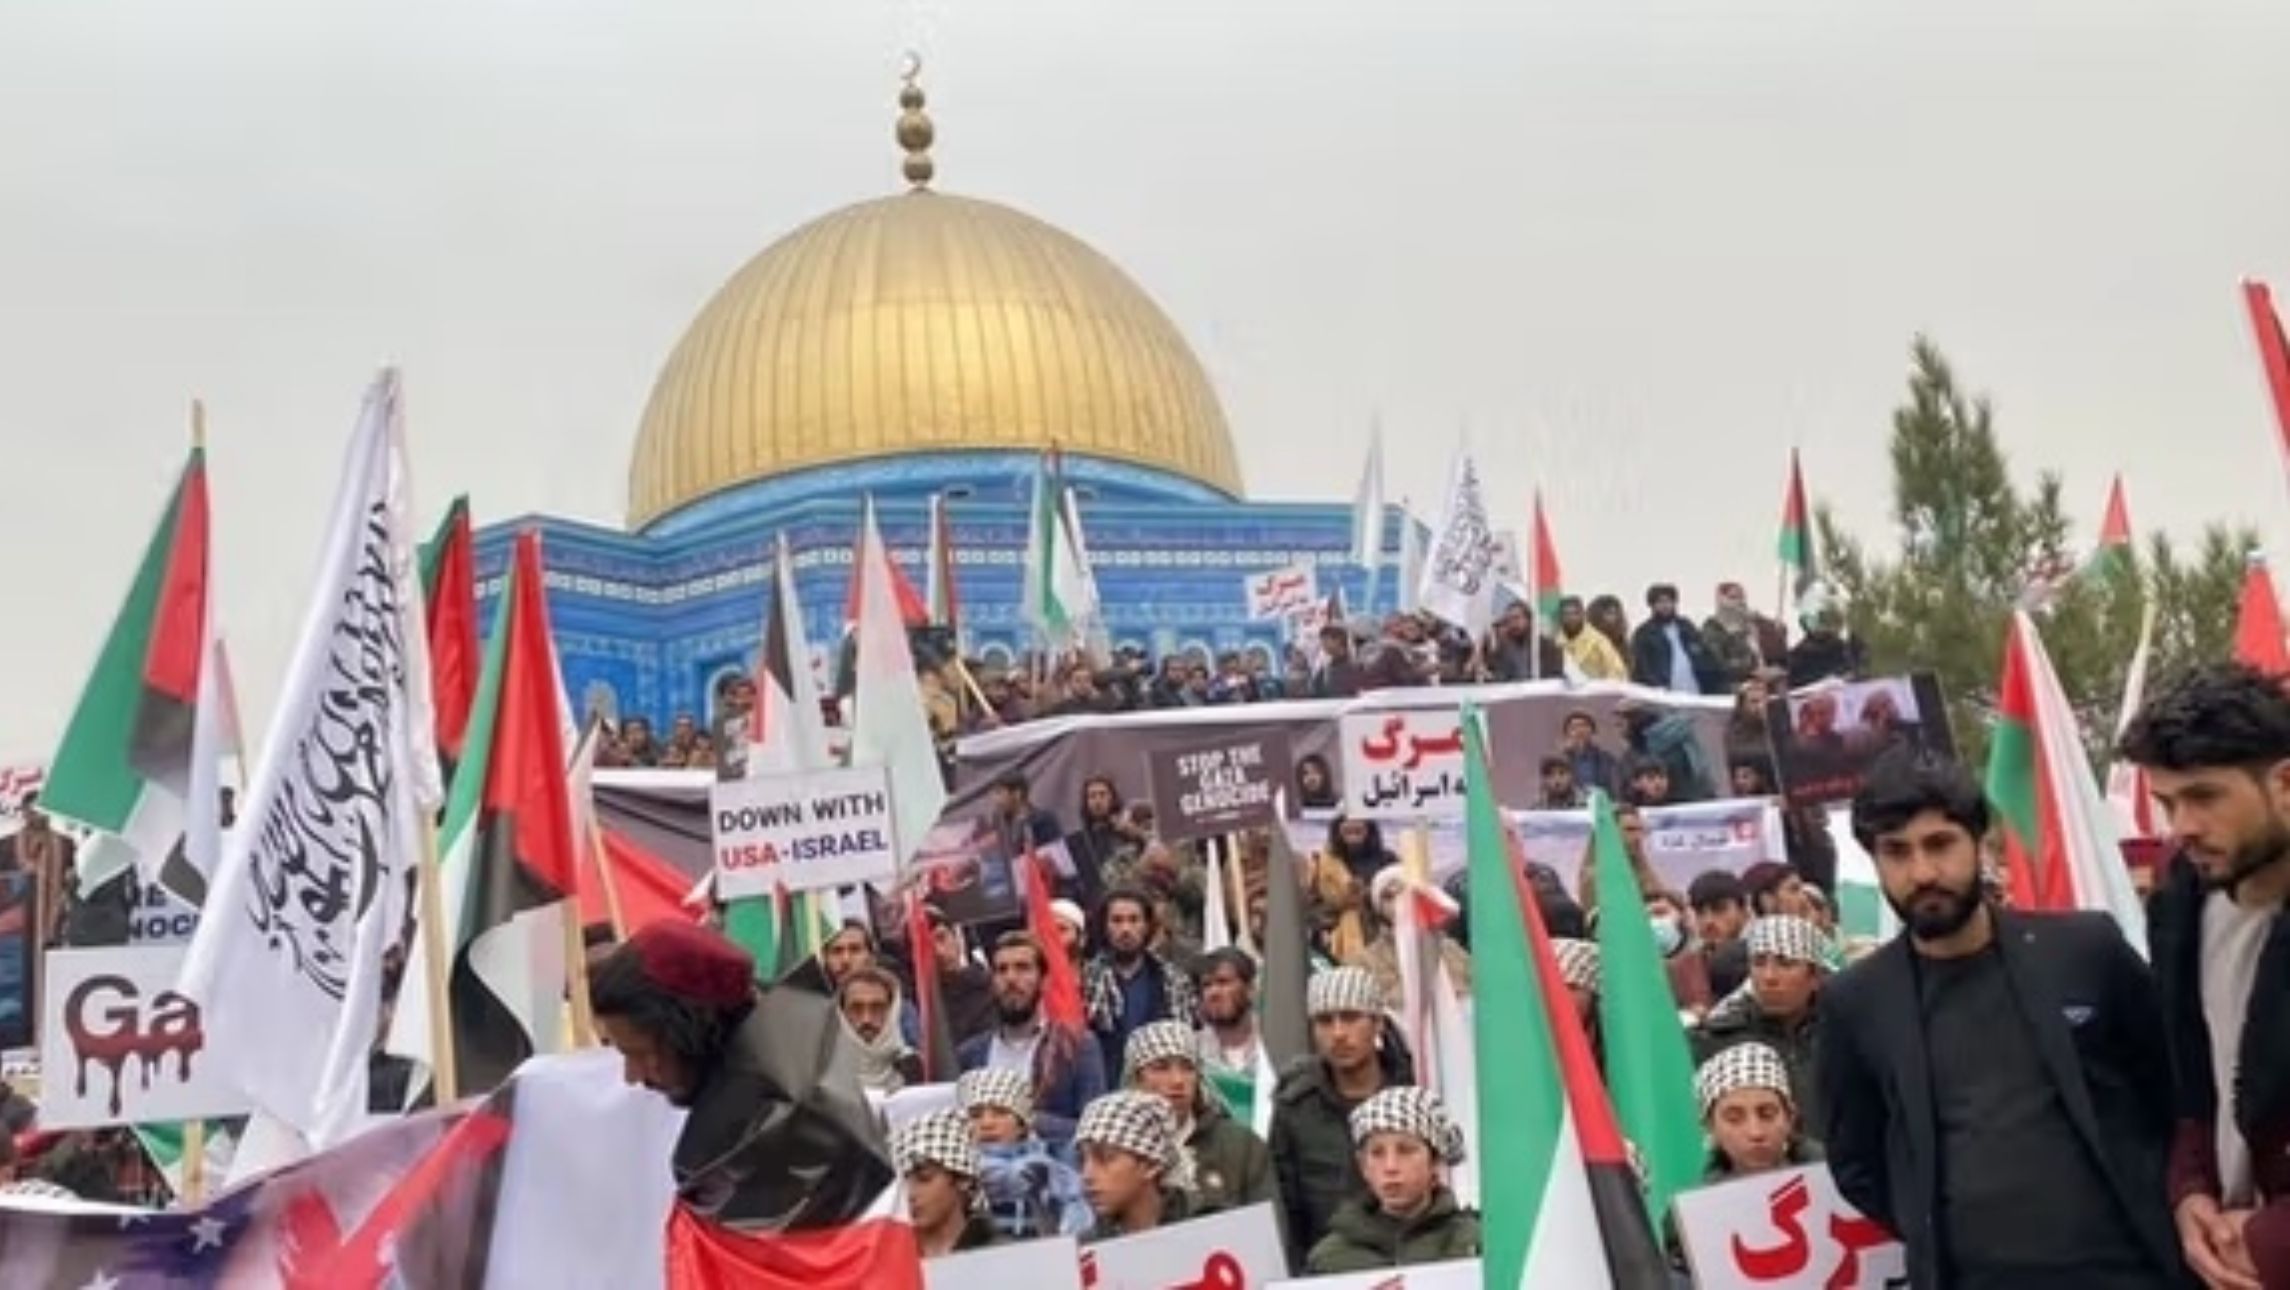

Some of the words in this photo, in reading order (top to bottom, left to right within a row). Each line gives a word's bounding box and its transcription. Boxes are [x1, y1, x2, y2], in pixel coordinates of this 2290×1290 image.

[1177, 750, 1224, 777] STOP
[1227, 742, 1262, 766] THE
[1200, 766, 1245, 790] GAZA
[719, 802, 802, 832] DOWN
[812, 791, 884, 820] WITH
[1180, 780, 1269, 815] GENOCIDE
[722, 829, 887, 870] USA-ISRAEL
